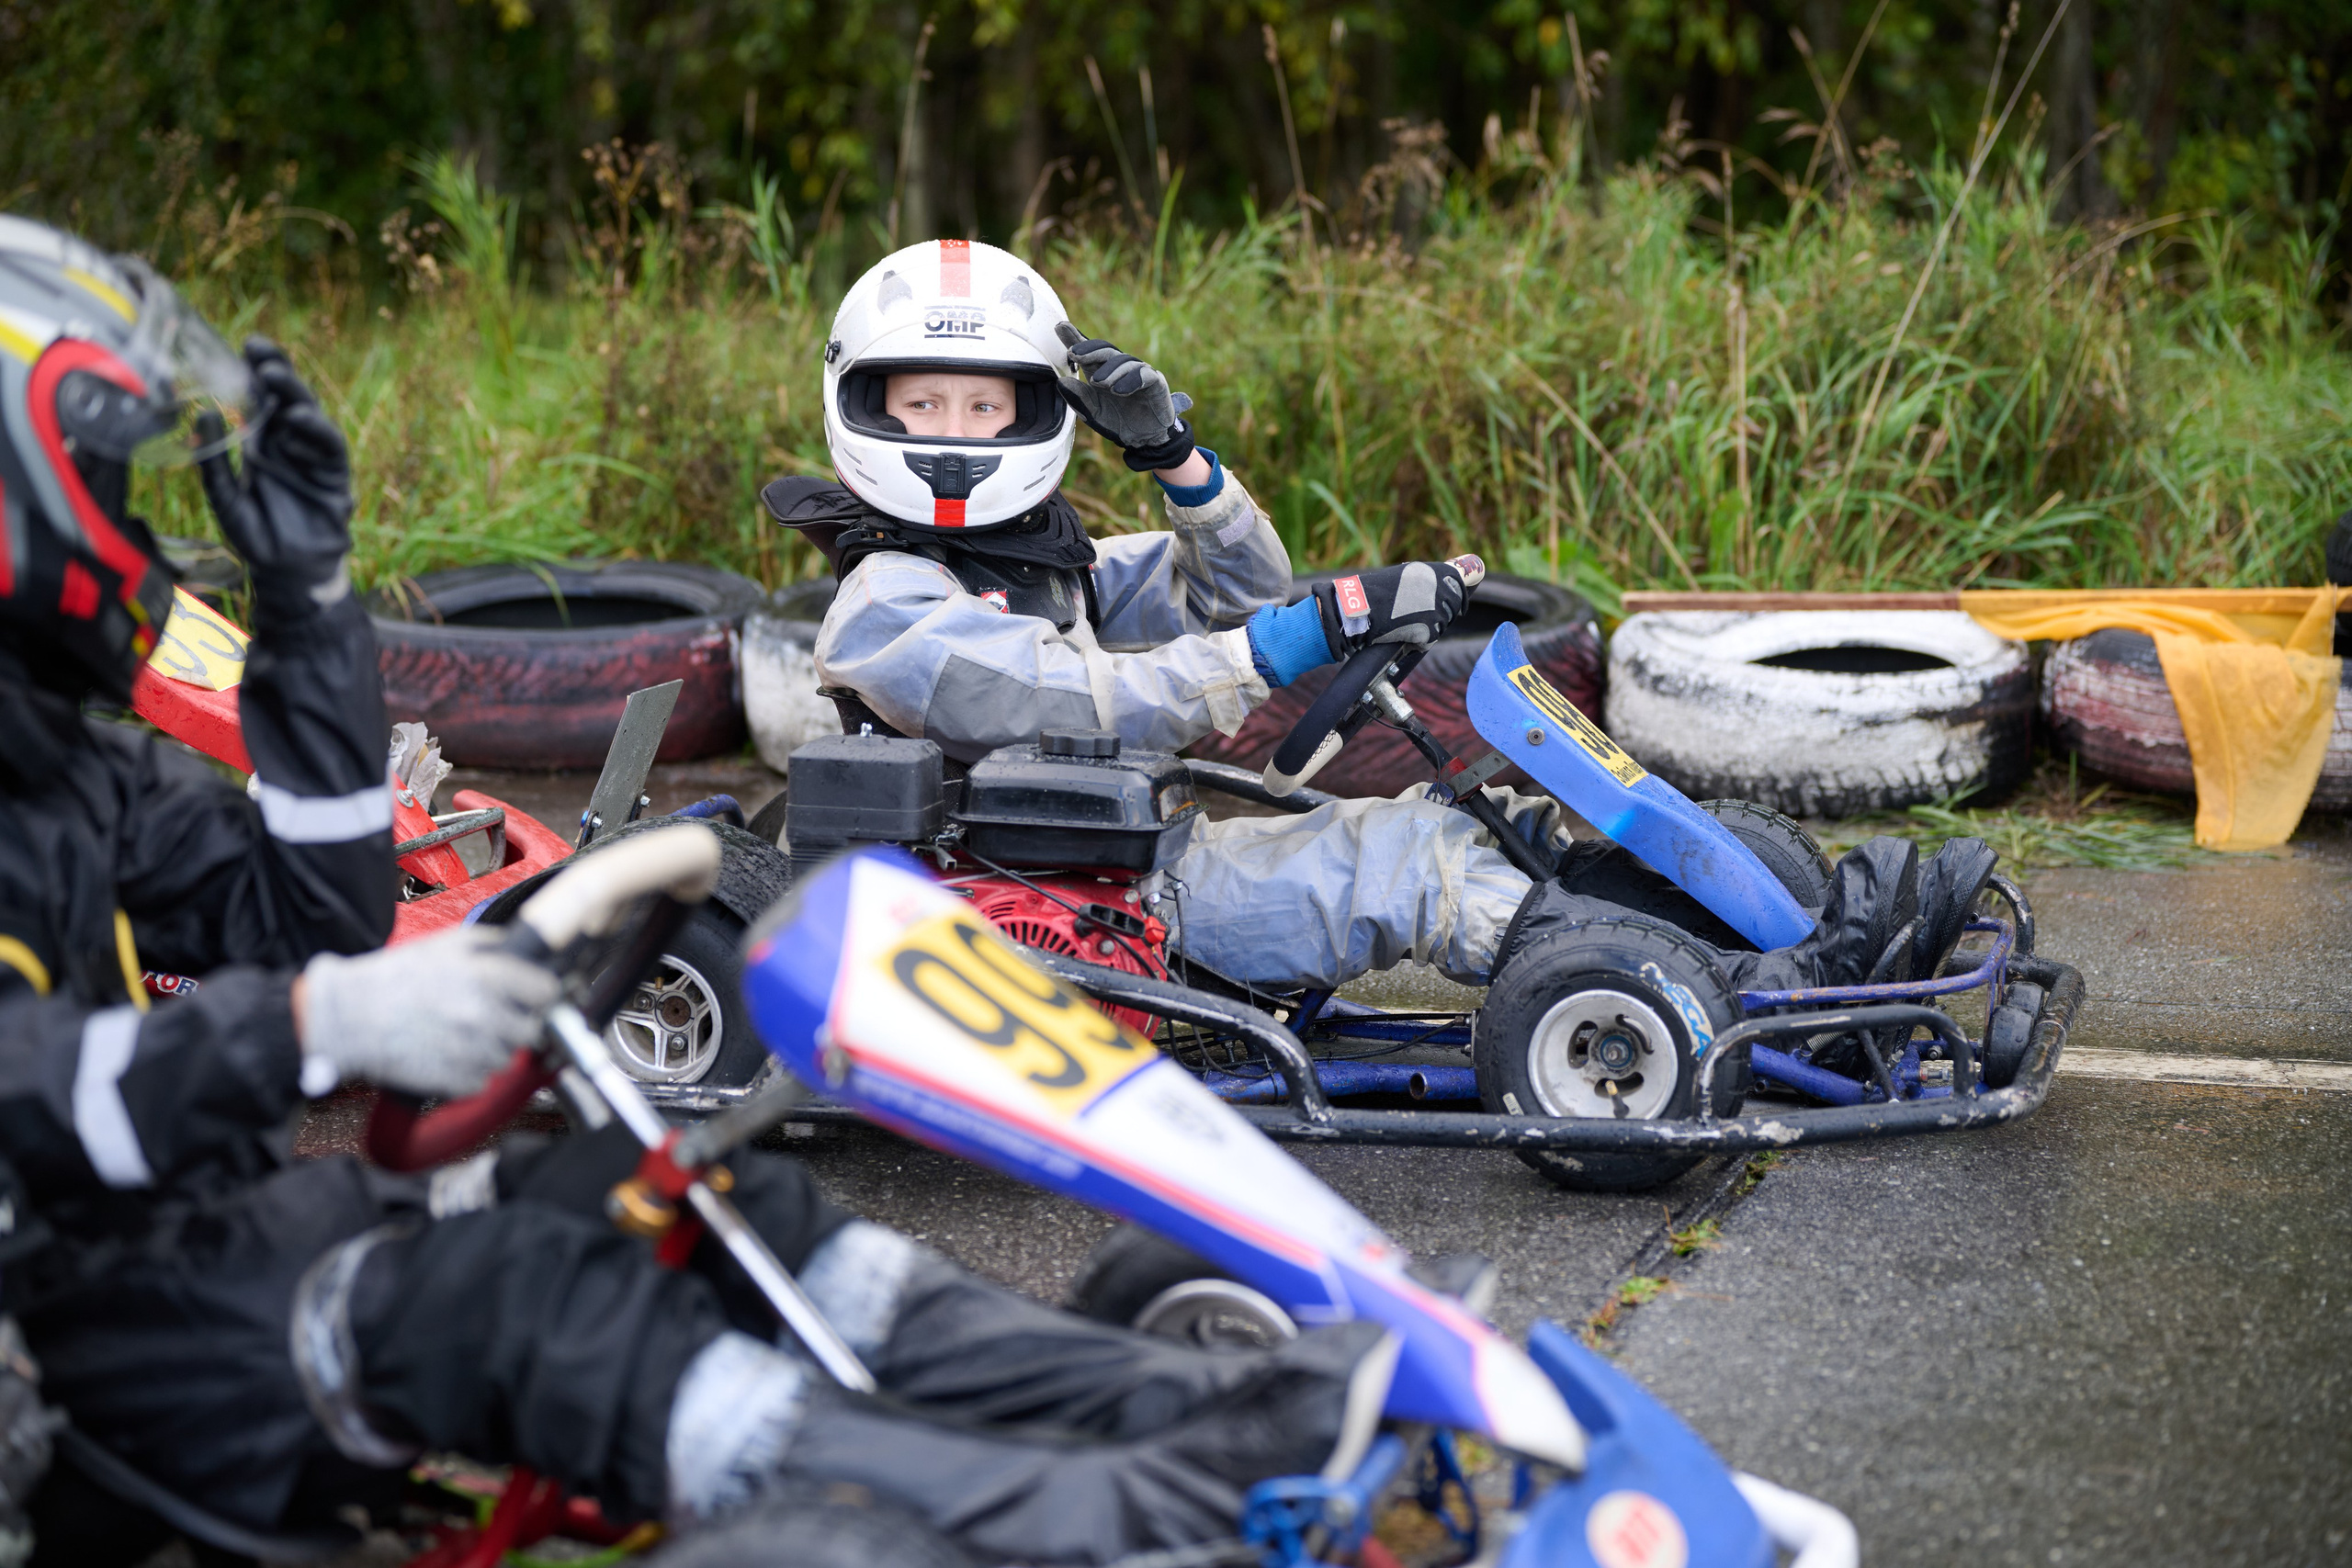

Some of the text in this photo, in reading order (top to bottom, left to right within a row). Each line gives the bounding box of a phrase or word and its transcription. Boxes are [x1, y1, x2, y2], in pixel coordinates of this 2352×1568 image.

[923, 310, 986, 333] OMP
[1341, 580, 1361, 610] RLG
[892, 921, 1136, 1089] 99
